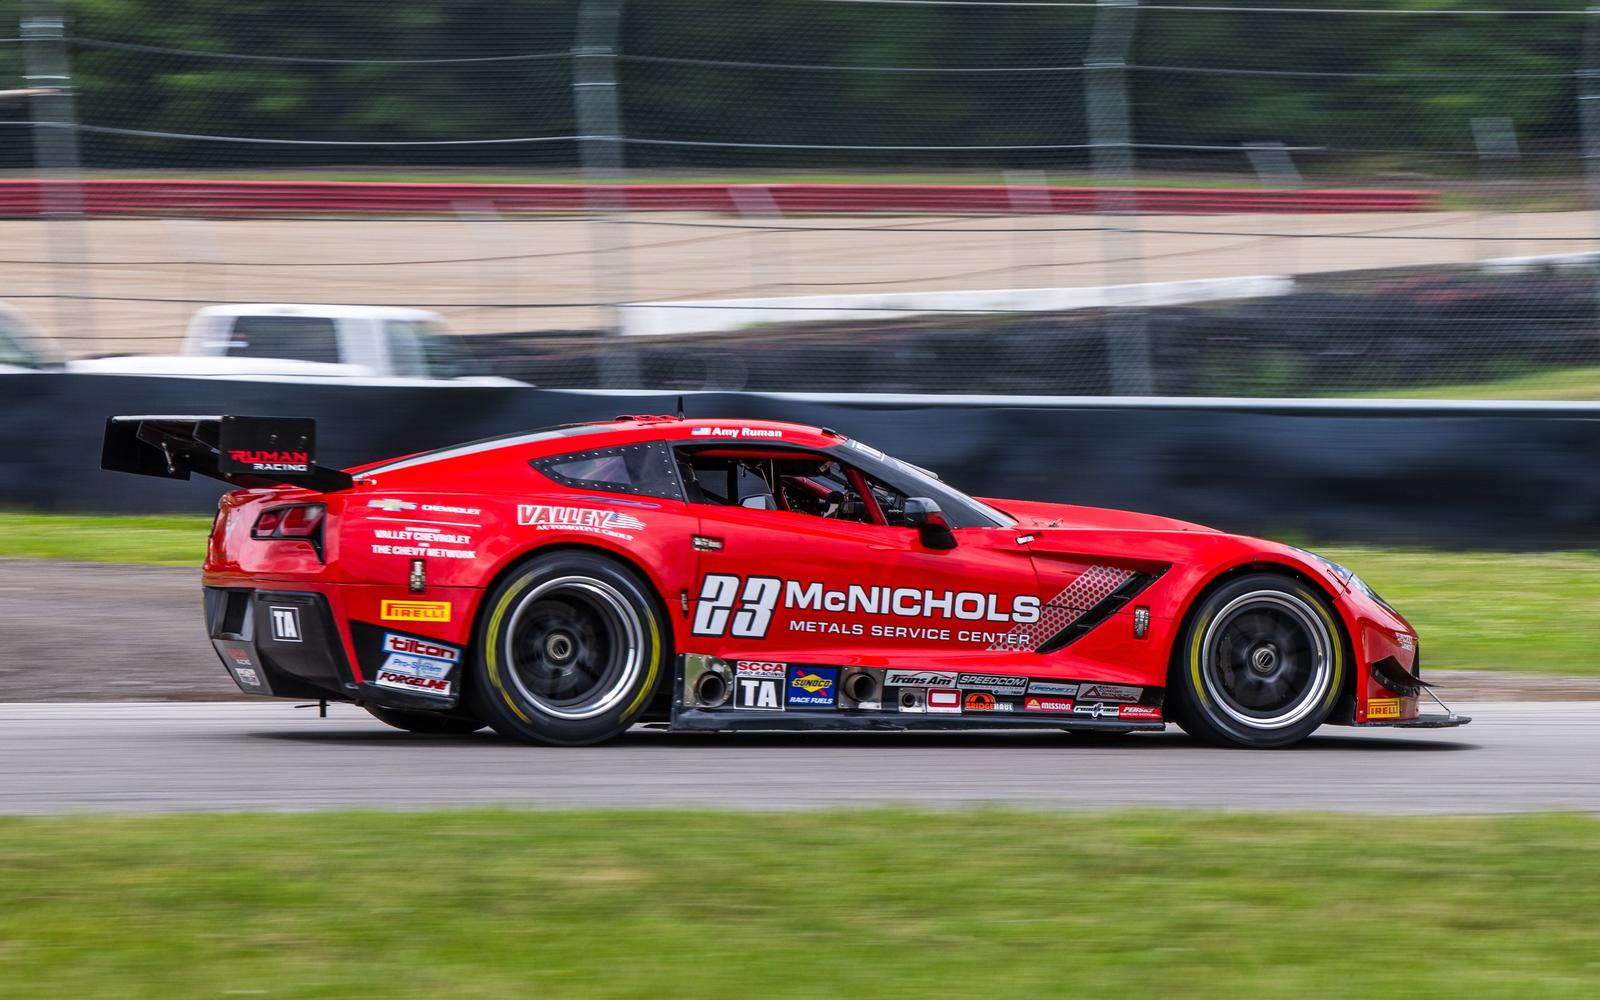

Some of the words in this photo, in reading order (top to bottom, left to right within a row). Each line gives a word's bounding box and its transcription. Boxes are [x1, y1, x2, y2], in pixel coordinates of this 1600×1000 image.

[712, 427, 739, 438] Amy
[742, 427, 783, 437] Ruman
[227, 450, 308, 464] RUMAN
[253, 463, 307, 471] RACING
[421, 504, 480, 515] CHEVROLET
[518, 504, 610, 529] VALLEY
[536, 524, 602, 534] AUTOMOTIVE
[374, 529, 412, 541] VALLEY
[412, 532, 471, 544] CHEVROLET
[371, 544, 391, 554] THE
[392, 546, 426, 557] CHEVY
[426, 548, 476, 559] NETWORK
[692, 573, 782, 639] 23
[785, 580, 1041, 623] McNICHOLS
[386, 602, 445, 618] PIRELLI
[273, 610, 298, 638] TA
[789, 620, 863, 635] METALS
[871, 625, 950, 641] SERVICE
[958, 630, 1030, 645] CENTER
[389, 638, 455, 658] tilton
[738, 661, 785, 673] SCCA
[379, 671, 449, 690] FORGELINE
[793, 679, 831, 688] SUNOCO
[888, 674, 927, 685] Trans
[926, 676, 952, 686] Am
[959, 675, 1025, 687] SPEEDCOM
[741, 680, 778, 707] TA
[789, 696, 810, 704] RACE
[1367, 702, 1397, 715] PIRELLI
